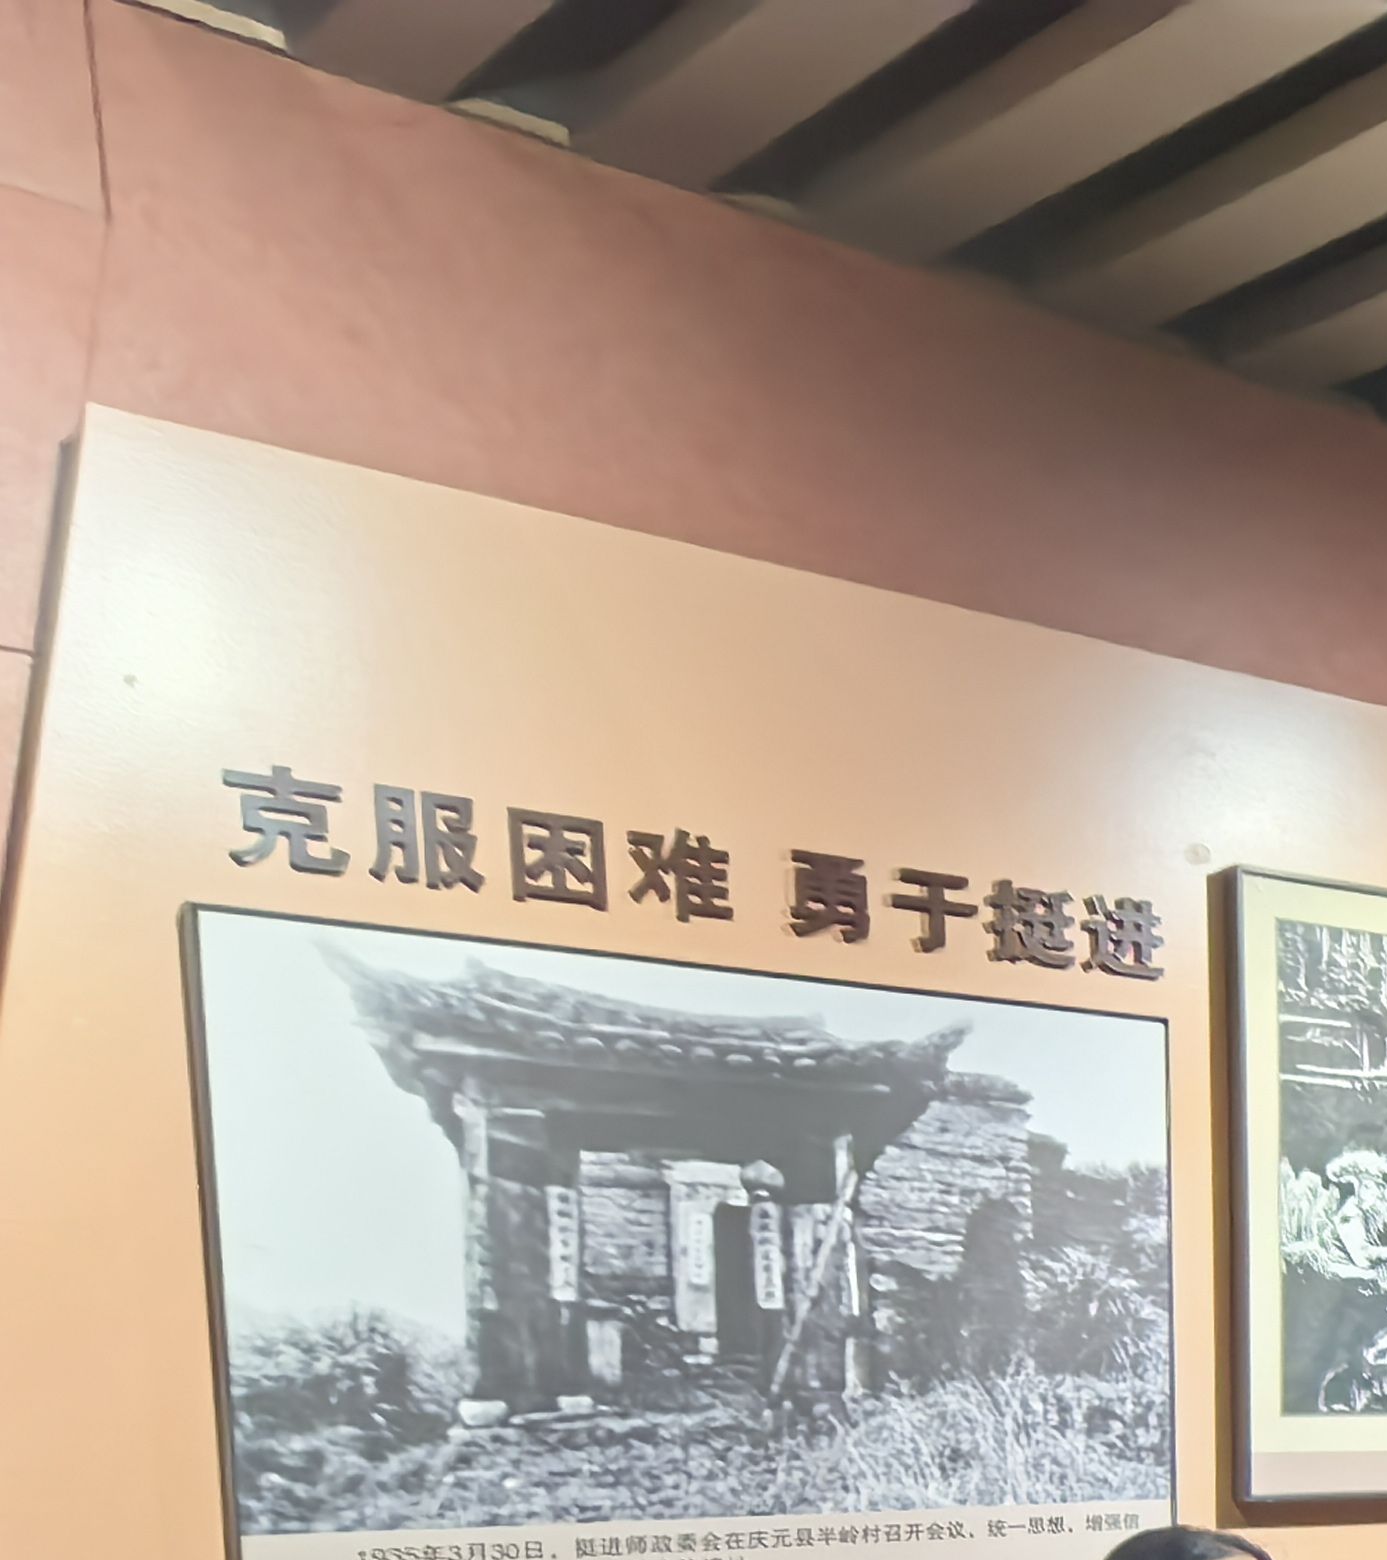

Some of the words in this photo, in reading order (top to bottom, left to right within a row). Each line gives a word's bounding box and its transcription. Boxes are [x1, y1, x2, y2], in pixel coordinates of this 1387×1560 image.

[222, 766, 735, 925] 克服困难
[785, 846, 1167, 980] 勇于挺进
